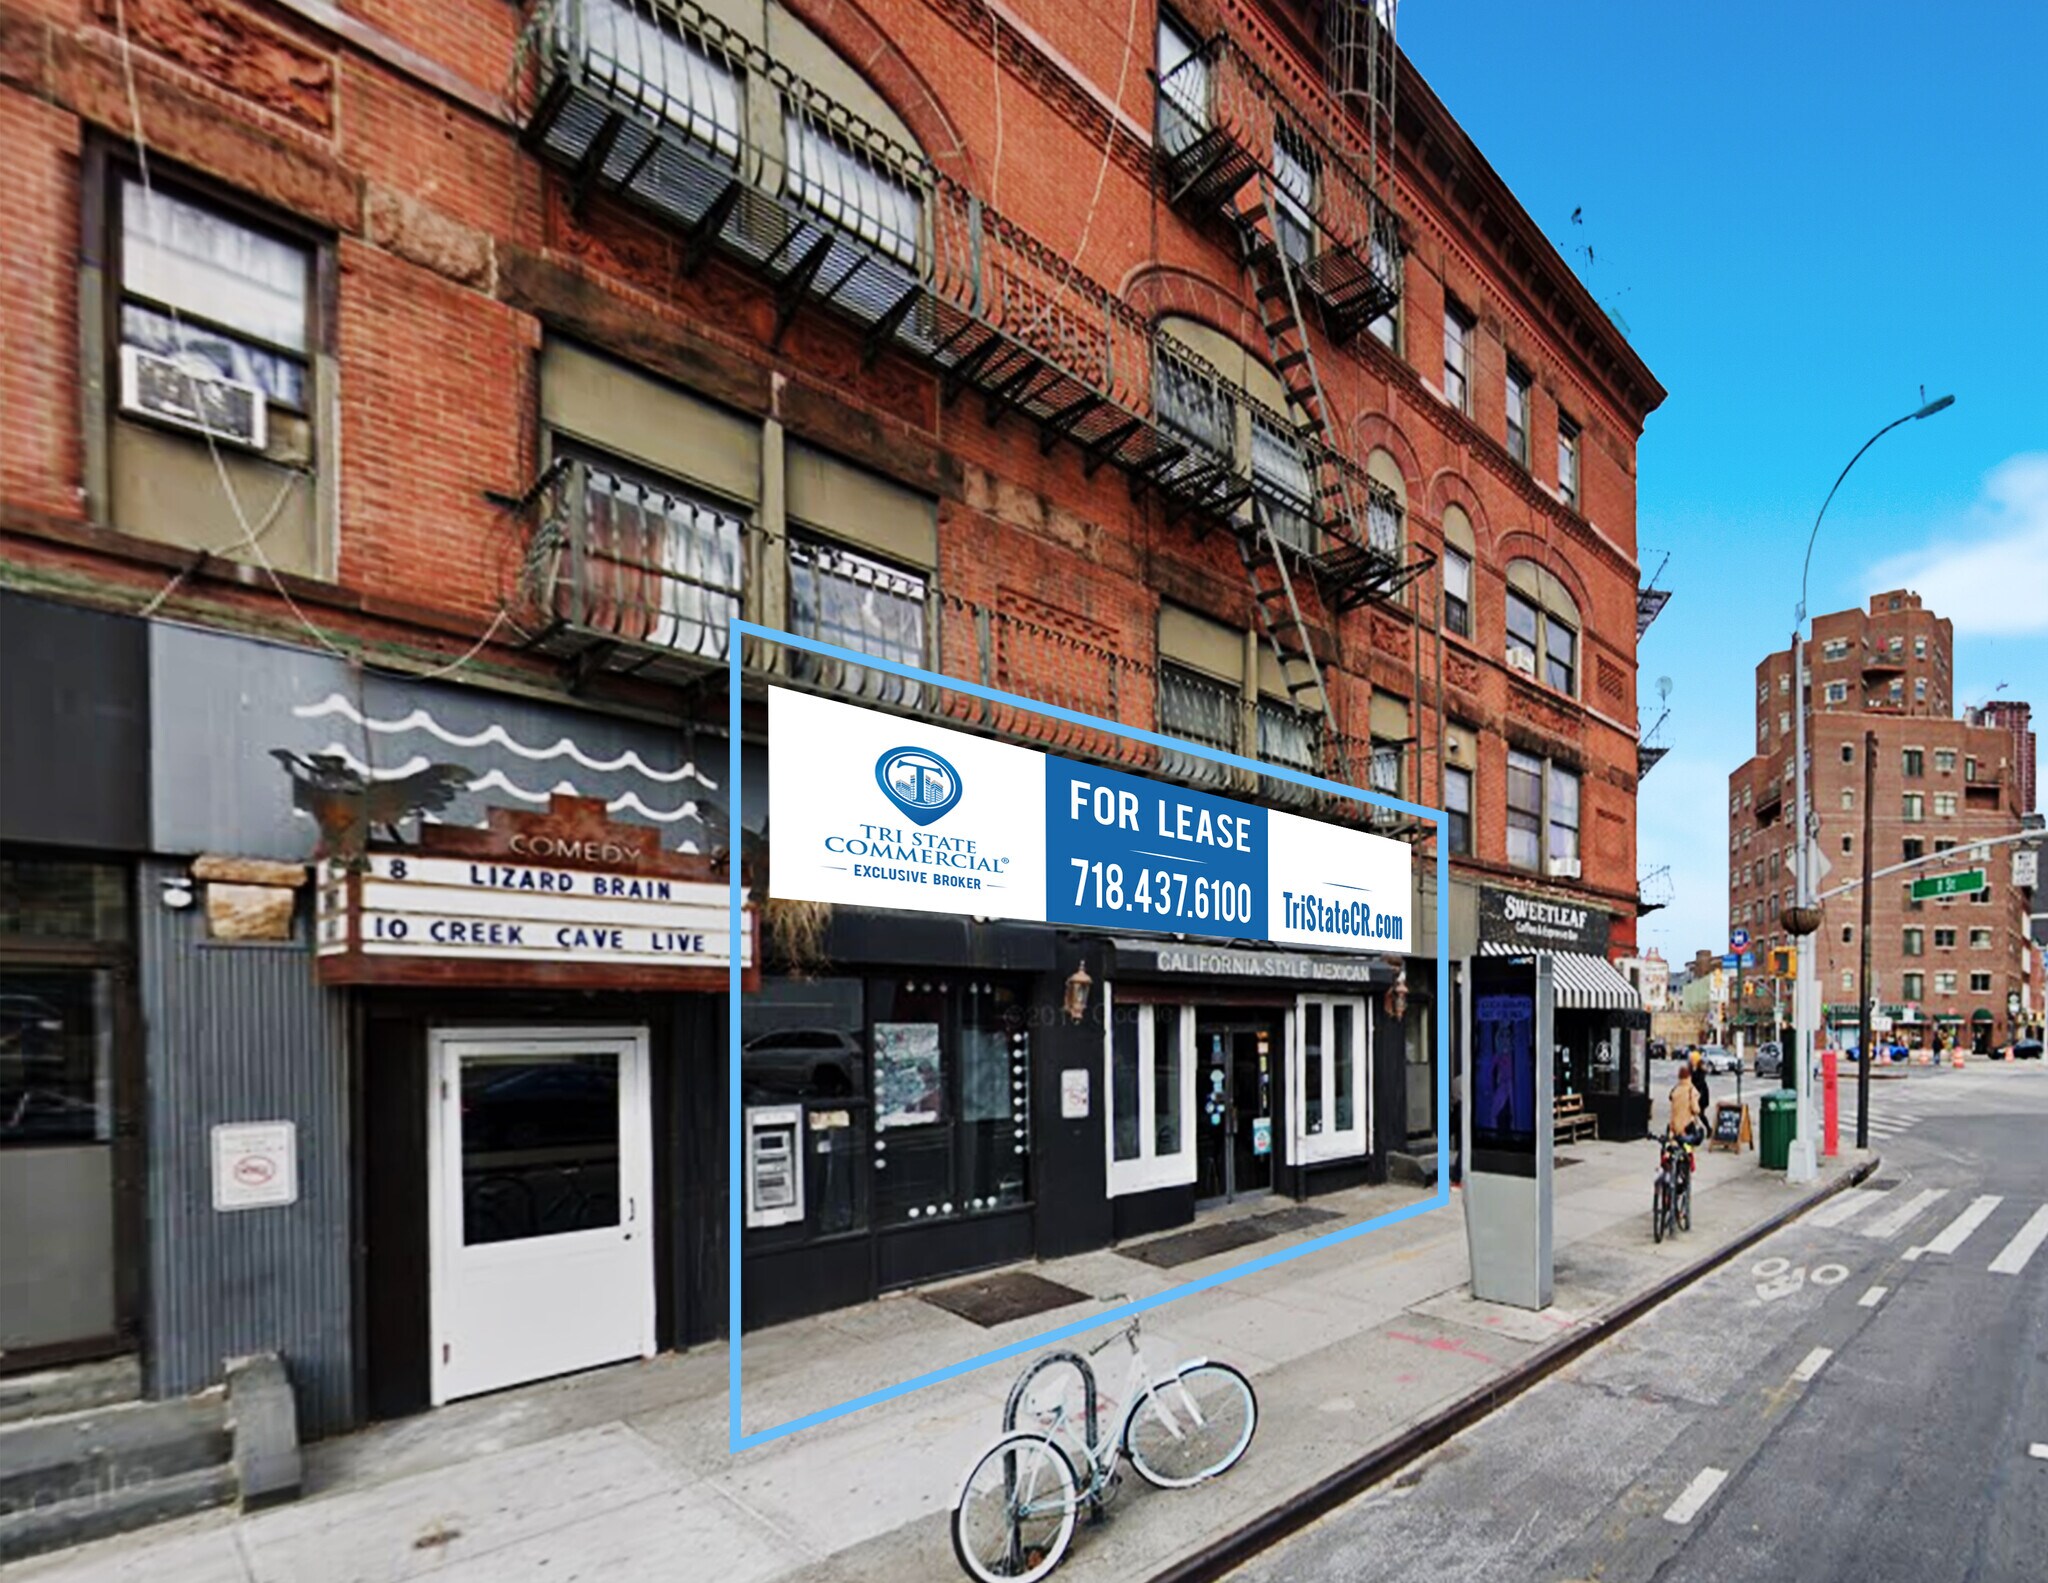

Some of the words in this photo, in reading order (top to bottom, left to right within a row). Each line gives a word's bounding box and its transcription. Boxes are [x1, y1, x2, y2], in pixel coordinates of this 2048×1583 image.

[509, 834, 644, 865] COMEDY
[389, 860, 409, 880] 8
[470, 865, 573, 892] LIZARD
[593, 876, 671, 900] BRAIN
[430, 921, 524, 945] CREEK
[557, 929, 624, 950] CAVE
[651, 933, 705, 953] LIVE
[1157, 951, 1308, 978] CALIFORNIA-STYLE
[1312, 963, 1370, 982] MEXICAN
